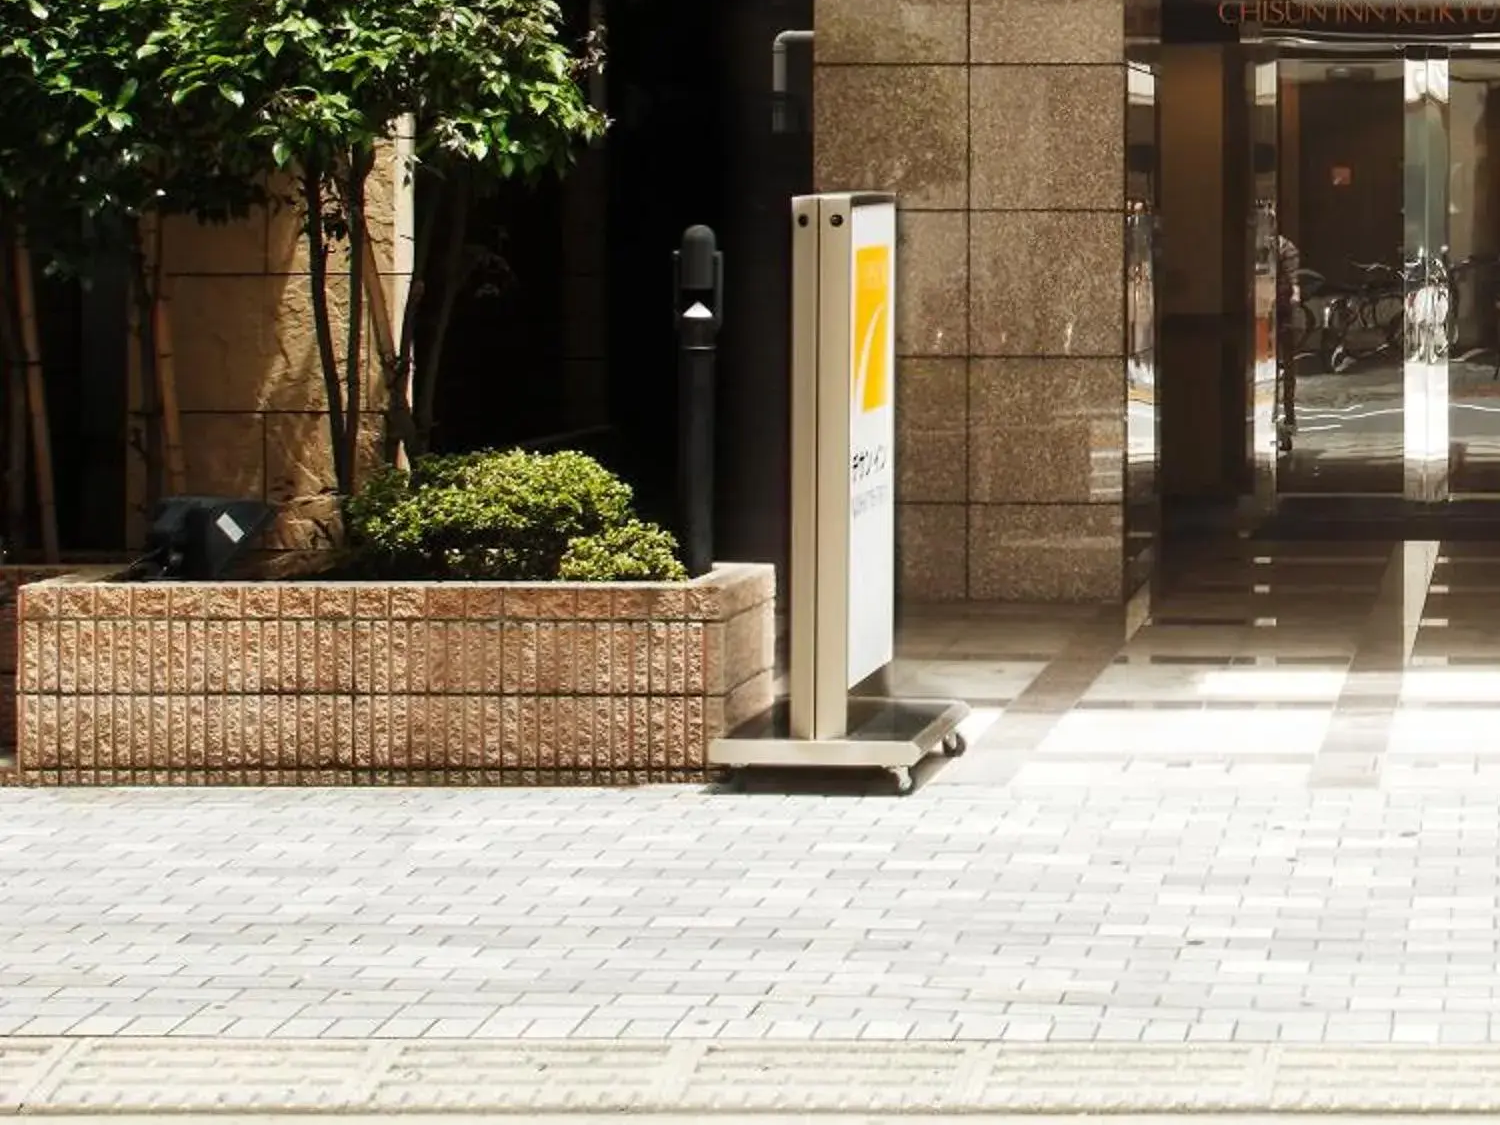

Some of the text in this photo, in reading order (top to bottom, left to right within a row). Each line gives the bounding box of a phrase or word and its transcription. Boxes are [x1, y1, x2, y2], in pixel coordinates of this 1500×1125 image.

[1217, 0, 1328, 24] CHISUN
[1335, 2, 1387, 23] INN
[1394, 1, 1500, 24] KEIKYU
